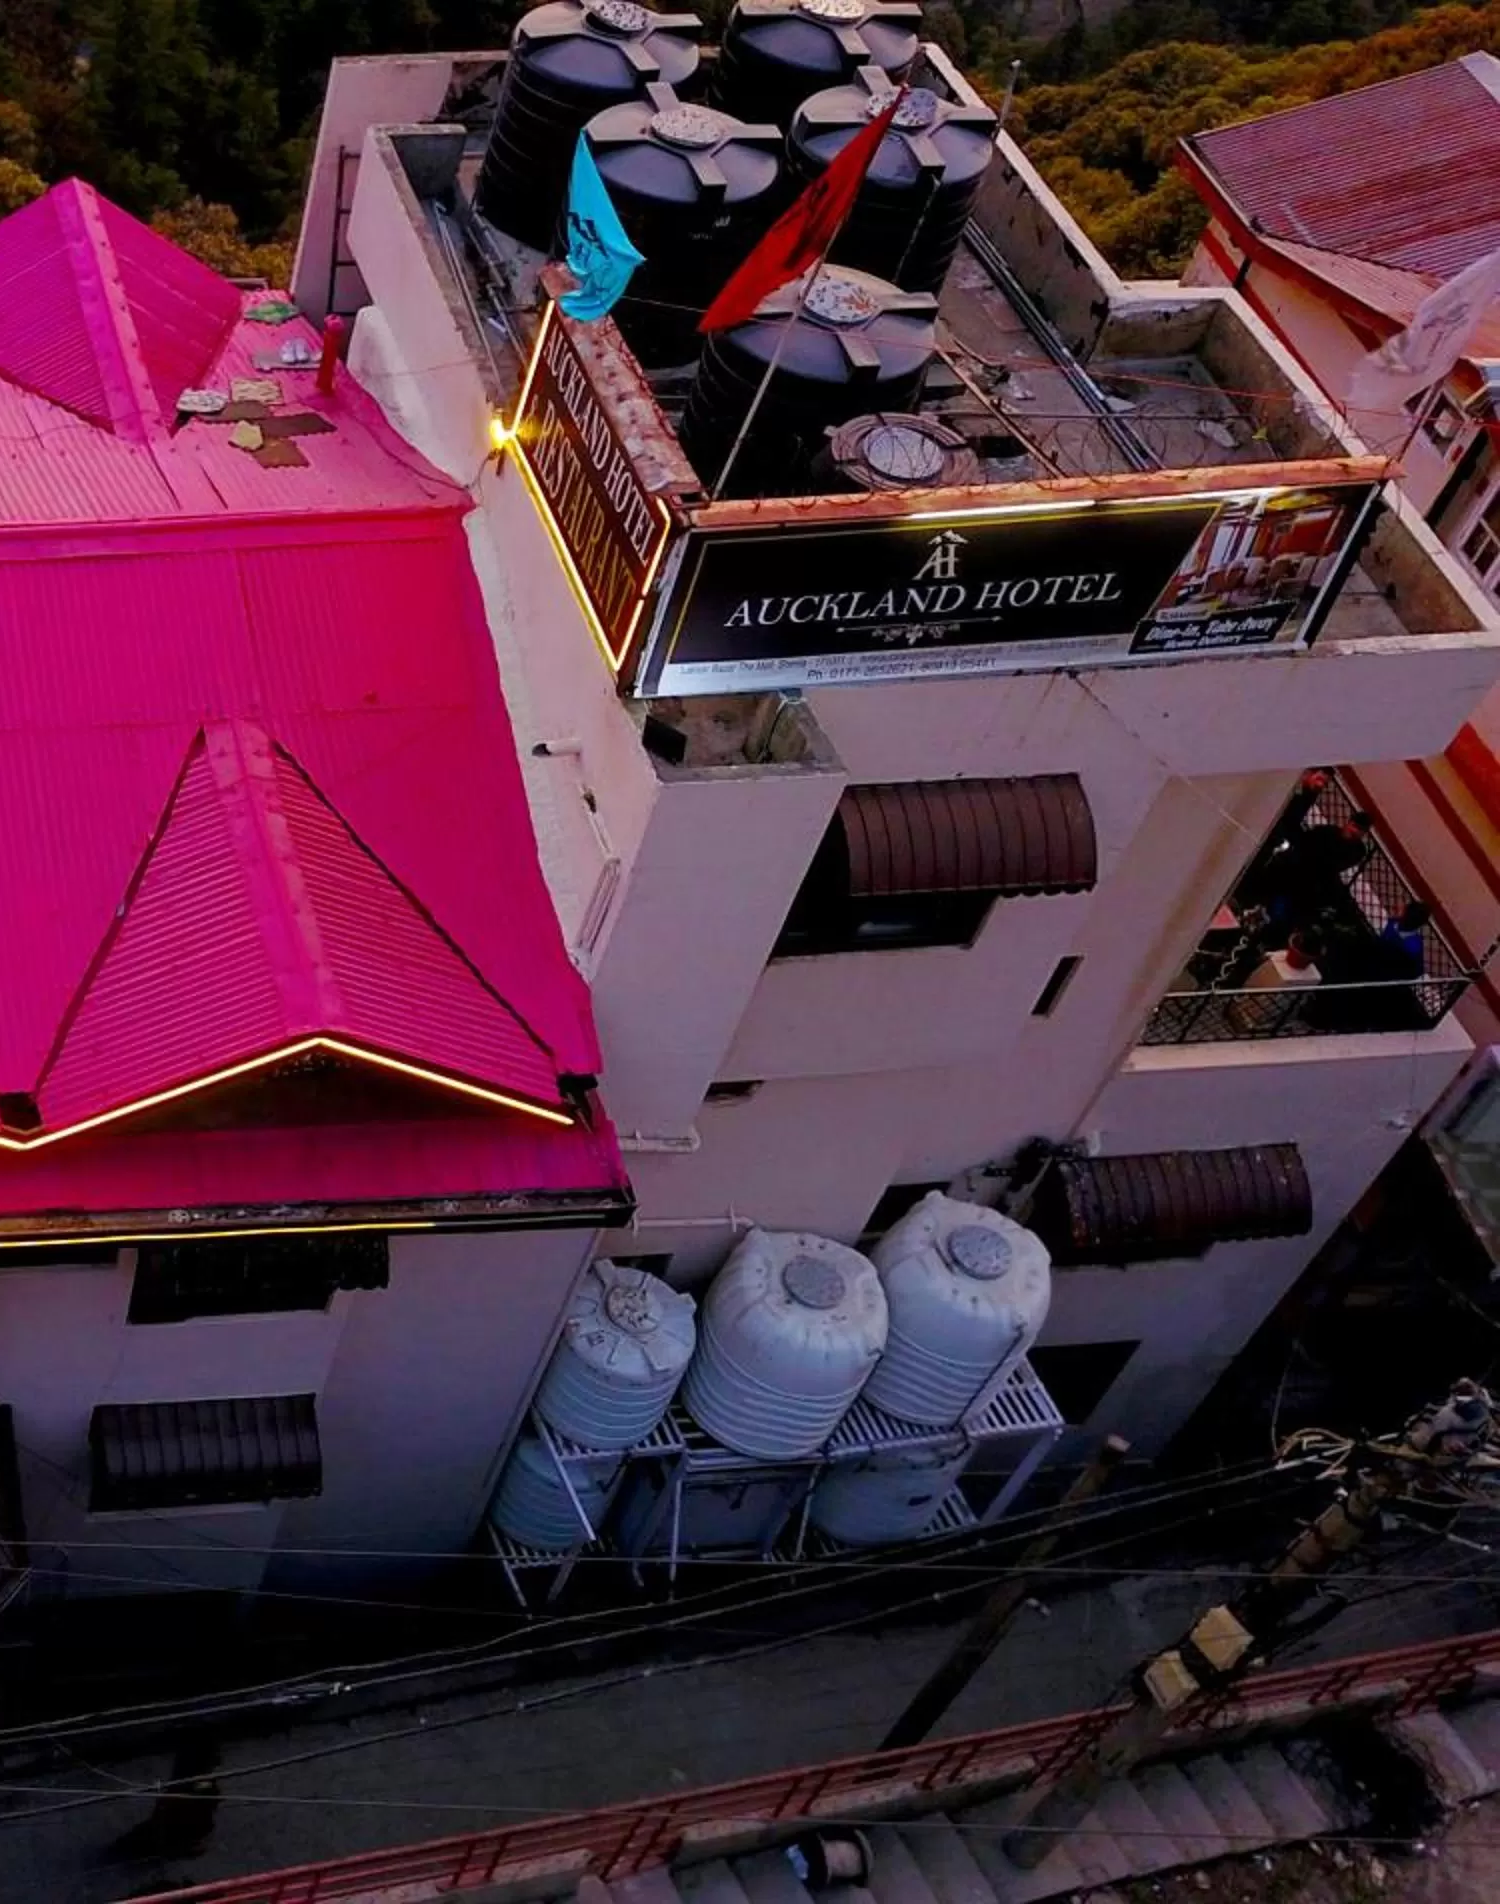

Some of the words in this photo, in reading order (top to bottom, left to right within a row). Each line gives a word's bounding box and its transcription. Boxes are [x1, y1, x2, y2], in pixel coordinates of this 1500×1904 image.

[532, 400, 638, 640] RESTAURANT
[542, 326, 607, 471] AUCKLAND
[604, 440, 657, 567] HOTEL
[723, 583, 966, 628] AUCKLAND
[974, 572, 1122, 610] HOTEL
